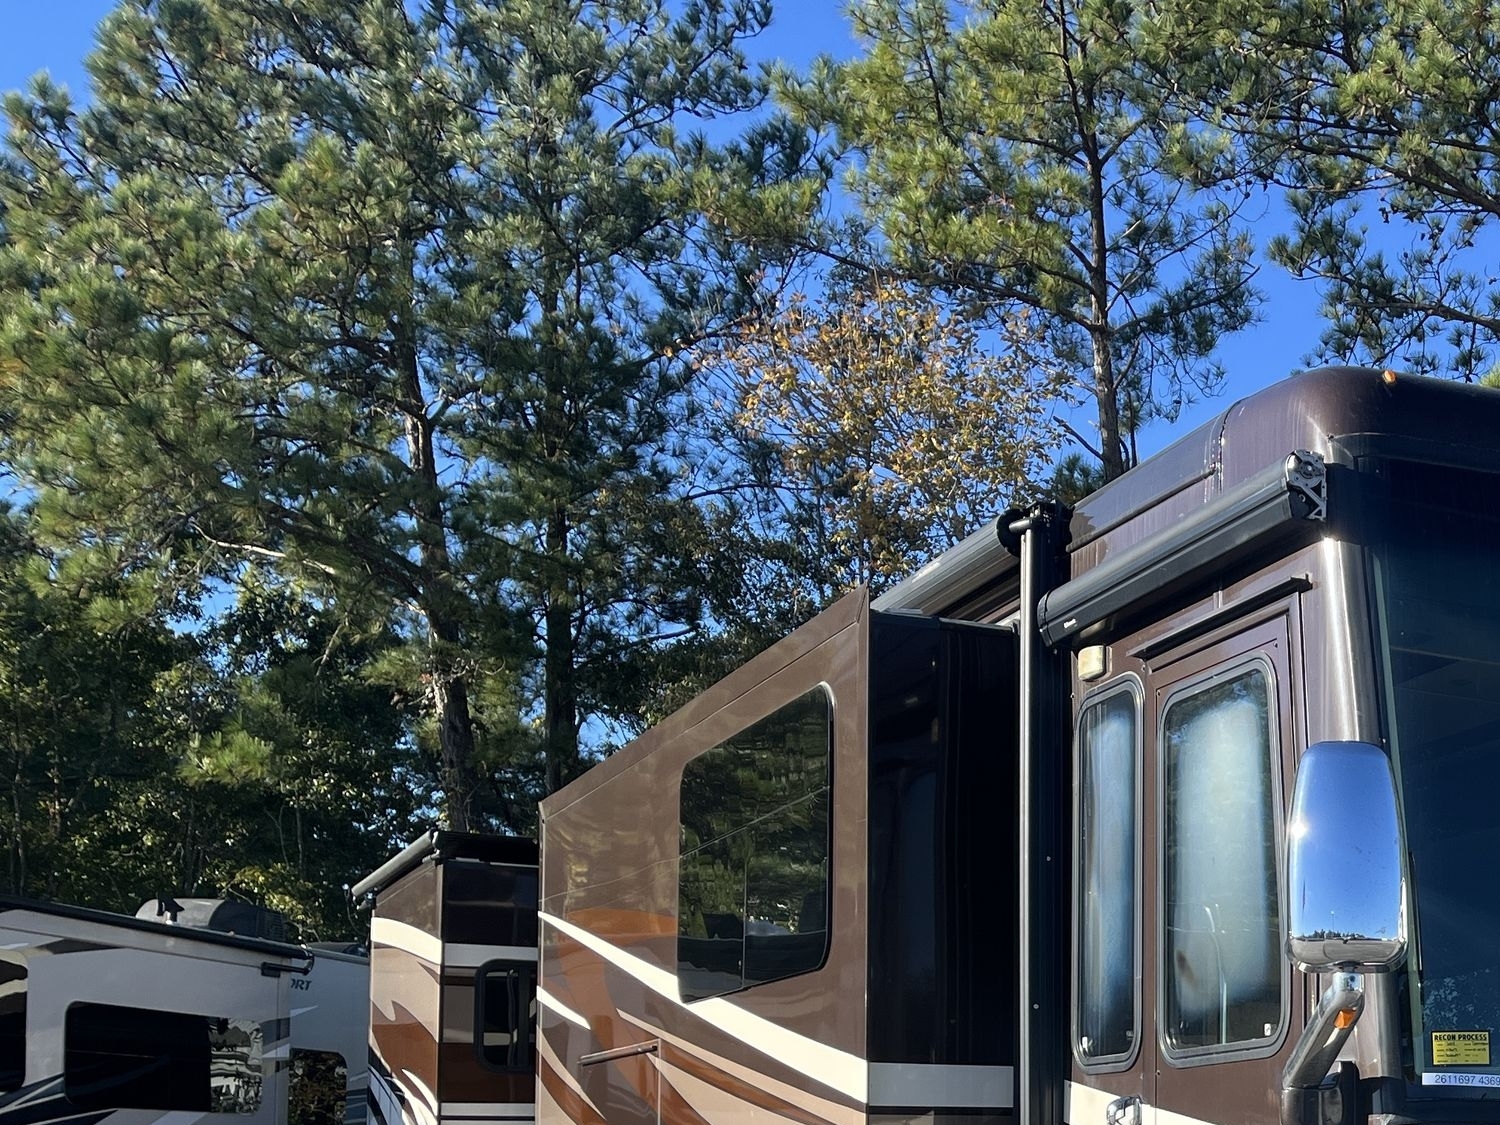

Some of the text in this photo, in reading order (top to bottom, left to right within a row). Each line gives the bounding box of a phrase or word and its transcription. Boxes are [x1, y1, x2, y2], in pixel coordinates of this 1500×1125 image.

[1433, 1033, 1487, 1041] RECON PROCESS
[1434, 1074, 1475, 1084] 2611697
